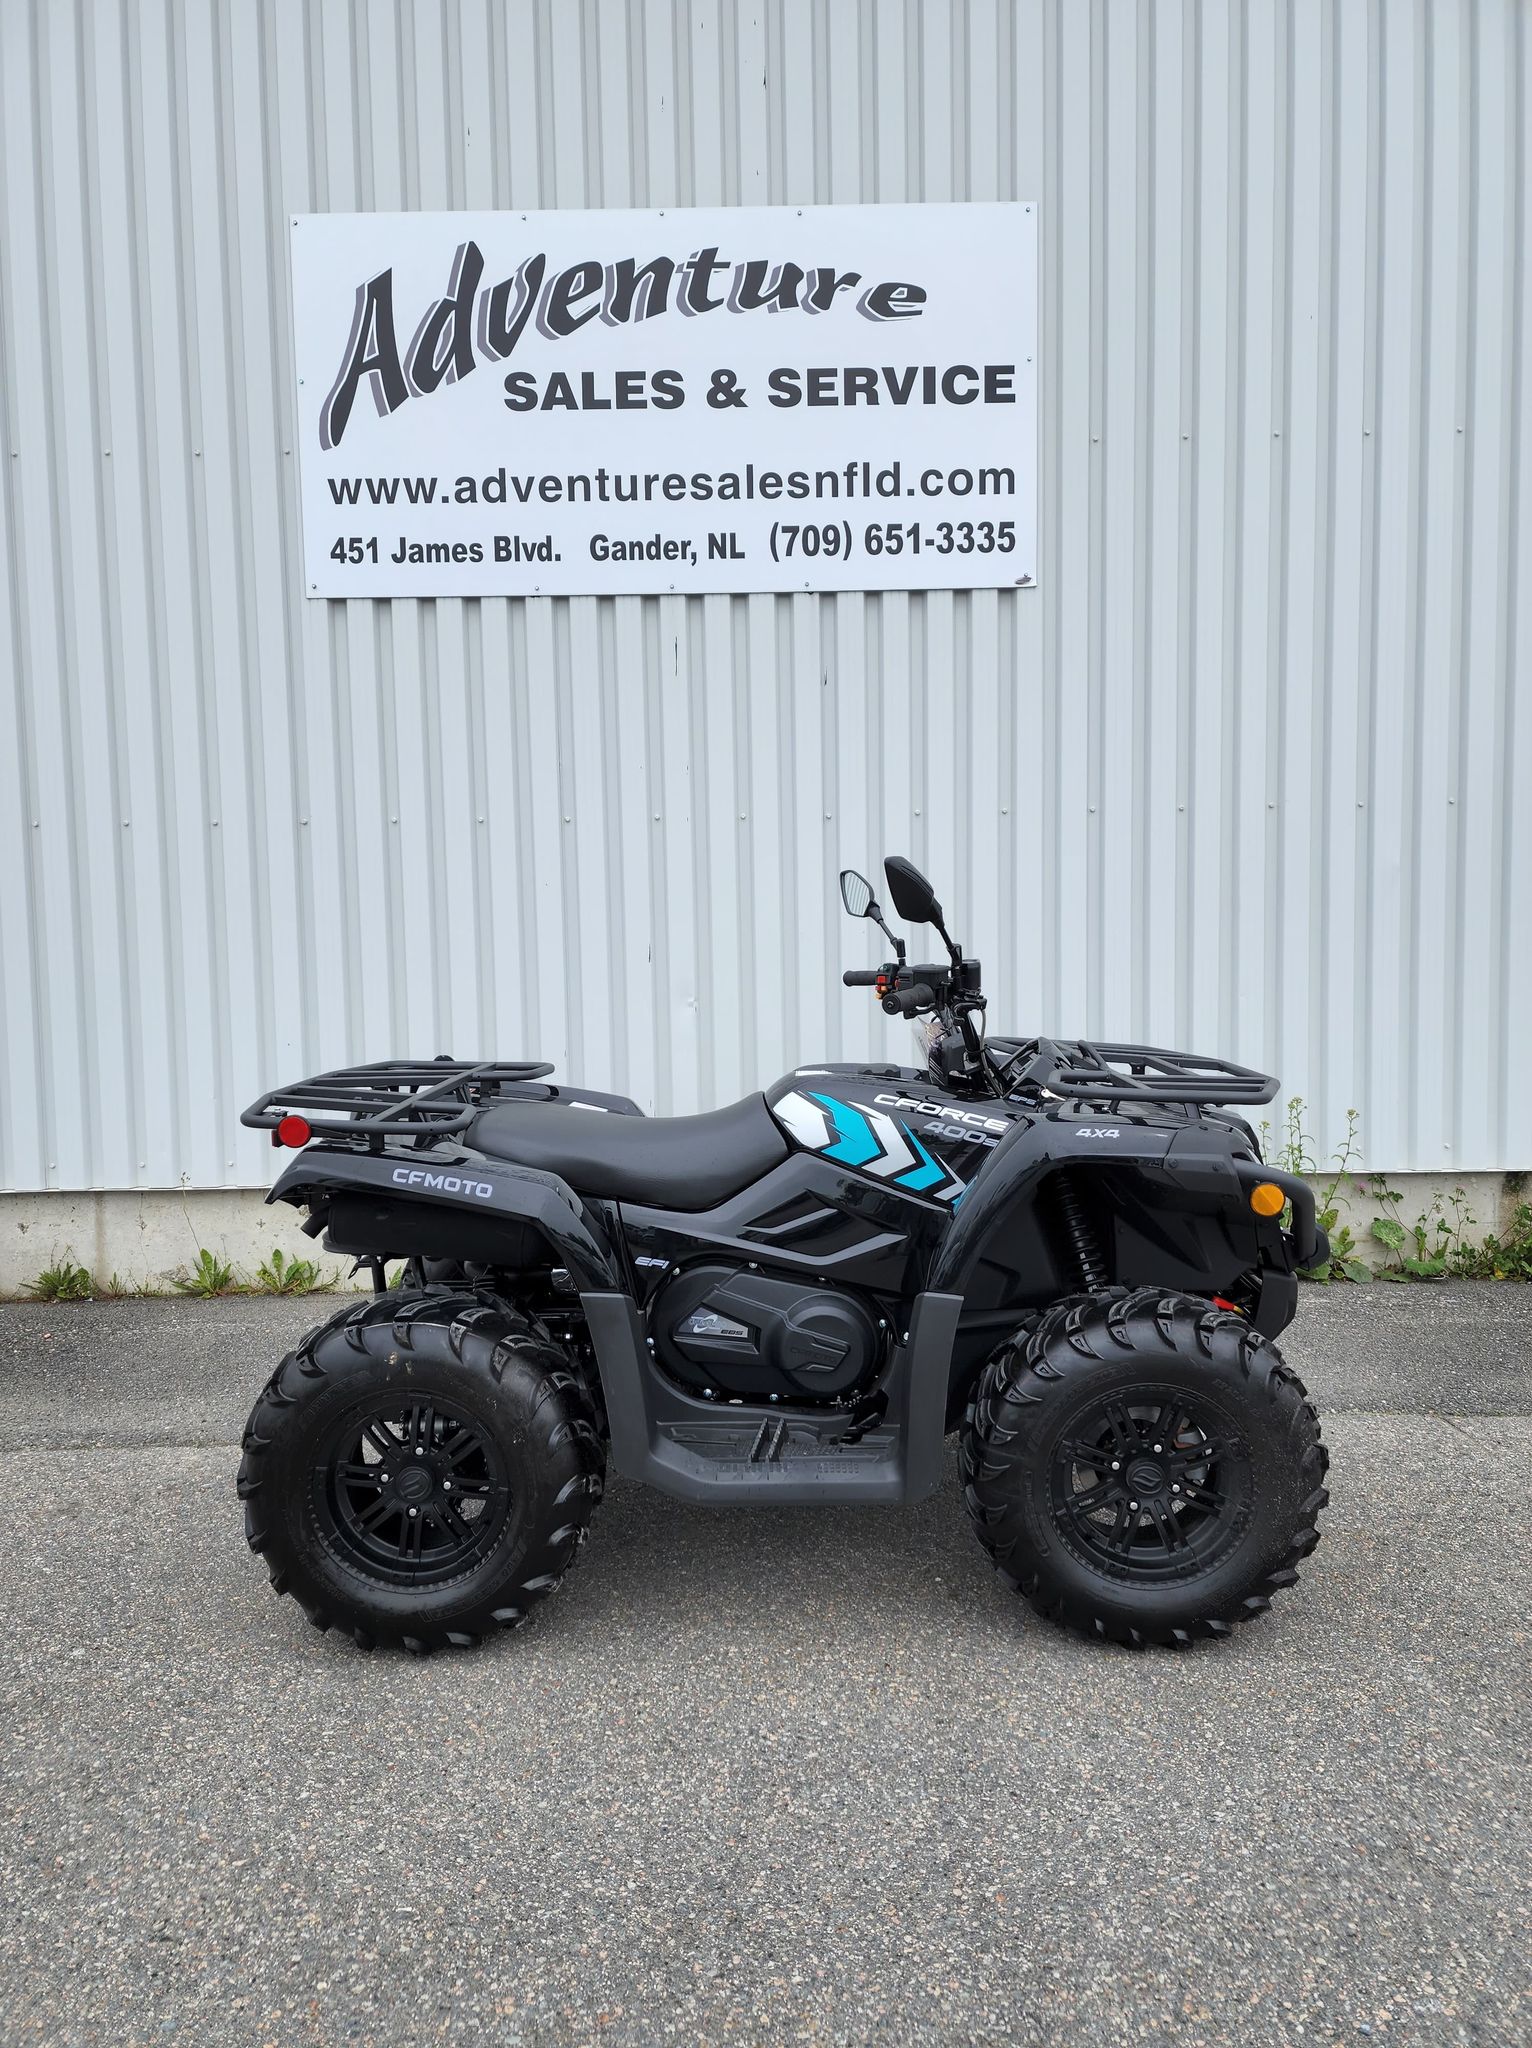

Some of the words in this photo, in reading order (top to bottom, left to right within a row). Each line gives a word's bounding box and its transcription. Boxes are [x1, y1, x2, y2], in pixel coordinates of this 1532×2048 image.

[319, 241, 927, 451] Adventure
[503, 369, 686, 412] SALES
[706, 368, 749, 410] &
[767, 364, 1016, 409] SERVICE
[327, 461, 1015, 505] www.adventuresalesnfld.com
[330, 536, 379, 565] 451
[390, 536, 484, 564] James
[493, 535, 562, 564] Blvd.
[589, 533, 697, 567] Gander,
[707, 532, 746, 560] NL
[769, 520, 853, 563] (709)
[864, 521, 1016, 556] 651-3335
[873, 1093, 1010, 1132] CFORCE
[1008, 1093, 1037, 1106] EPS
[392, 1168, 494, 1199] CFMOTO
[634, 1256, 670, 1270] EFI
